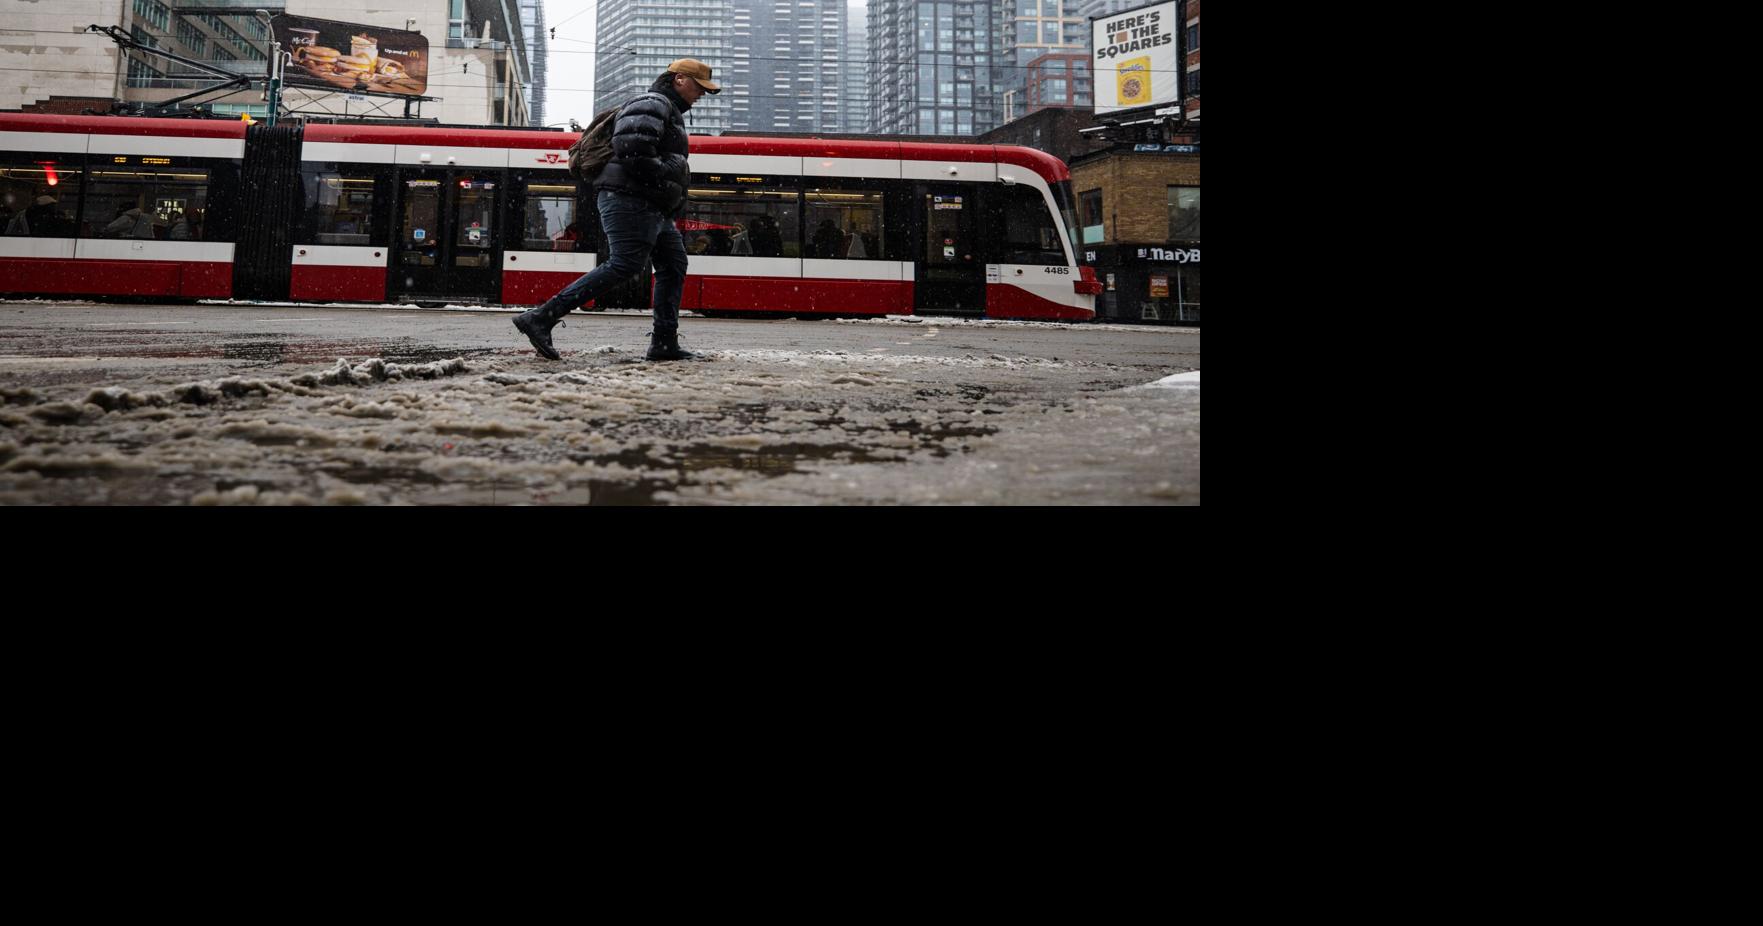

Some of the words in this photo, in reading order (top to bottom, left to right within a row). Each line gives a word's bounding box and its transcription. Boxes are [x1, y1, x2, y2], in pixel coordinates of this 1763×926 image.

[1106, 11, 1160, 33] HERE'S
[1131, 23, 1159, 39] THE
[1097, 33, 1172, 59] SQUARES
[1044, 266, 1070, 274] 4485
